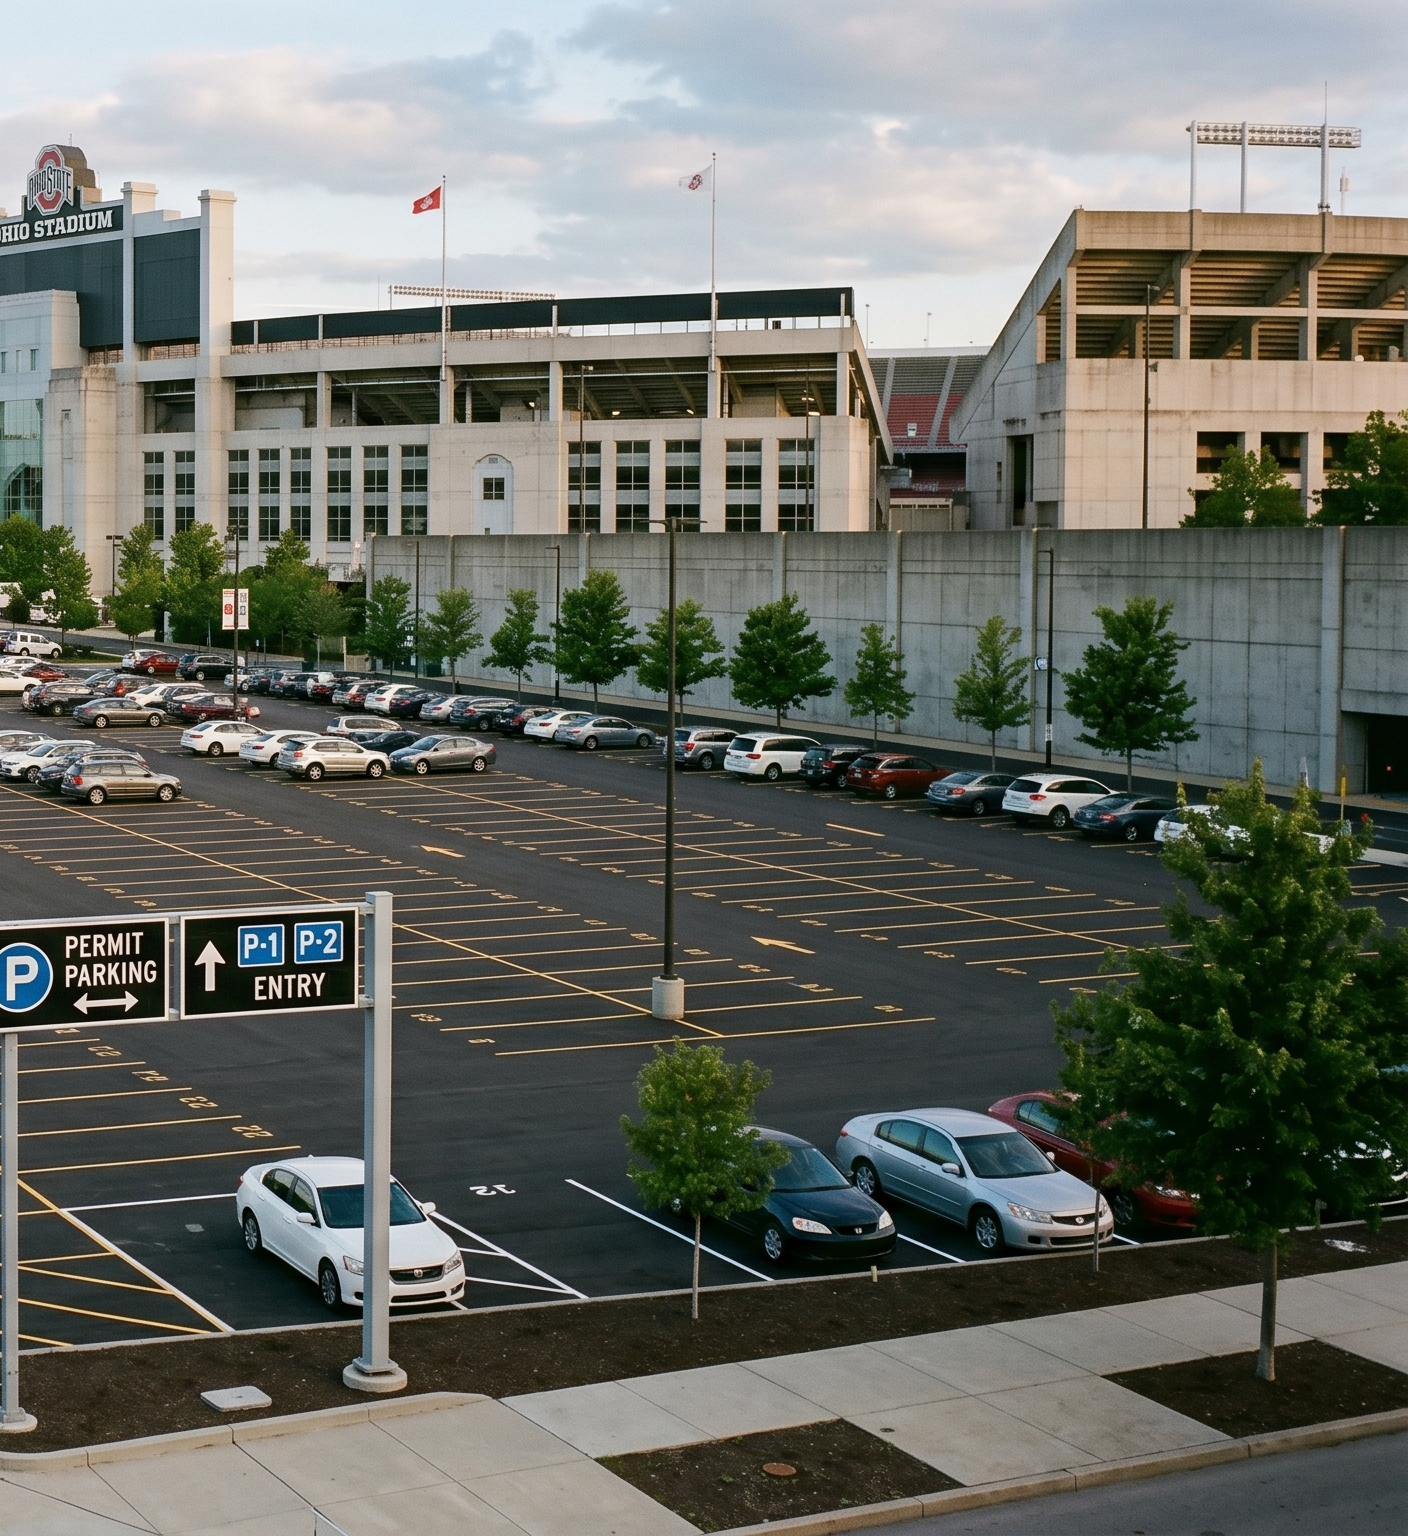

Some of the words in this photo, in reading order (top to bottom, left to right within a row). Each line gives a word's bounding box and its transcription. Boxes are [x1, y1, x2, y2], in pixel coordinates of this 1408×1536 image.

[34, 210, 112, 237] STADIUM
[65, 932, 144, 958] PERMIT
[244, 932, 277, 959] P-1
[299, 928, 337, 955] P-2
[6, 955, 40, 1001] P
[65, 960, 157, 988] PARKING
[254, 972, 326, 1001] ENTRY
